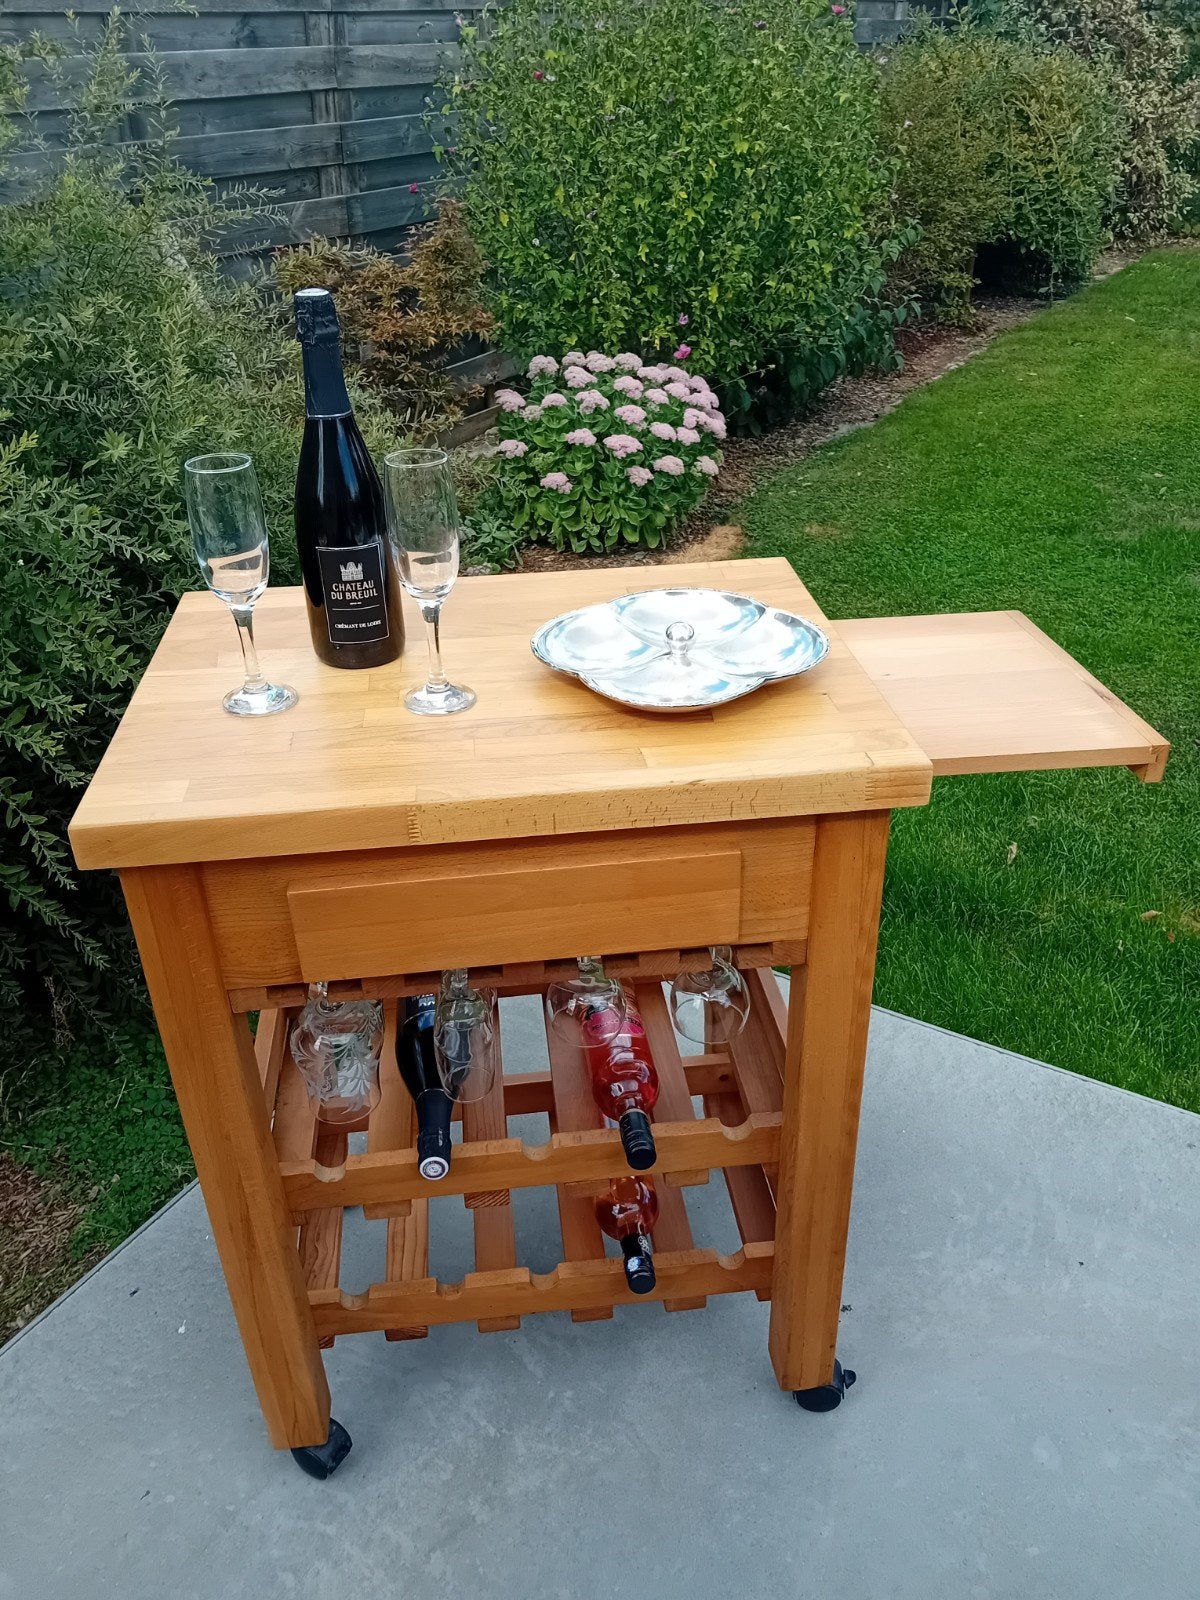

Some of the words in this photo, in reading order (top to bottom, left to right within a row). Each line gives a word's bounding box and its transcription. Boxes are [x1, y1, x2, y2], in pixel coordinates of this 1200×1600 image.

[332, 580, 374, 592] CHATEAU
[331, 591, 343, 600] DU
[345, 588, 378, 600] BREUIL
